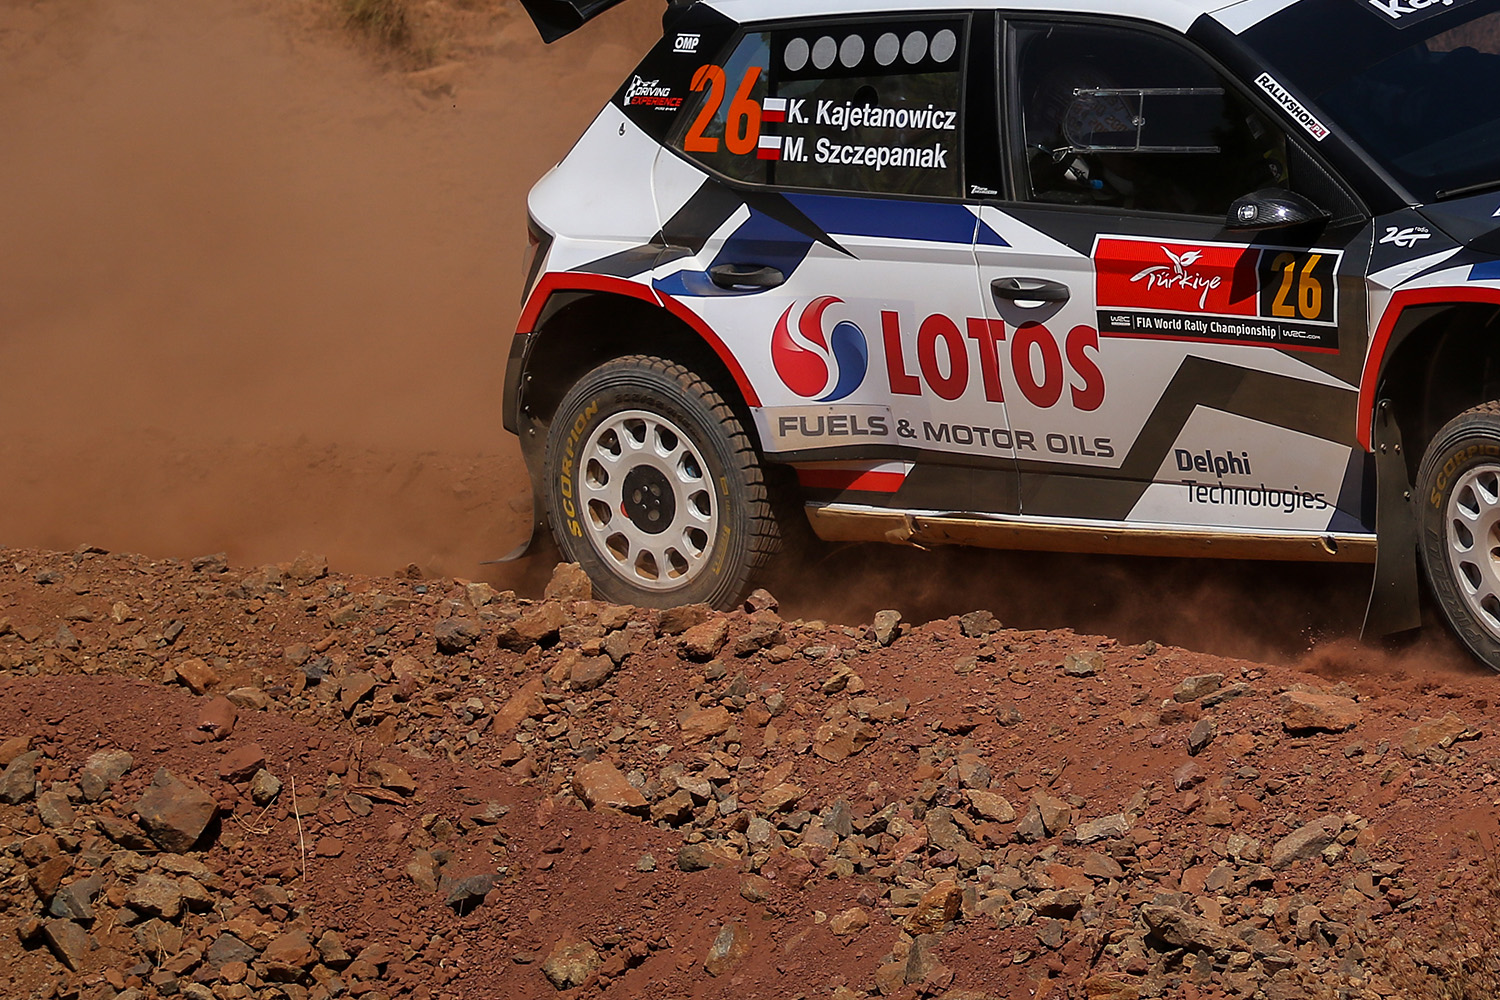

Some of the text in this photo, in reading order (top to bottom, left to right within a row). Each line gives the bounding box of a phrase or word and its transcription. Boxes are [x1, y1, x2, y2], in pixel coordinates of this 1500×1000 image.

[674, 35, 700, 50] OMP
[630, 96, 684, 108] EXPERIENCE
[634, 86, 672, 98] DRIVING
[684, 63, 763, 155] 26
[1258, 74, 1327, 138] RALLYSHOP.PL
[788, 98, 957, 131] K. Kajetanowicz
[782, 136, 809, 162] M.
[1130, 265, 1221, 310] Türkiye
[1270, 252, 1323, 319] 26
[1136, 316, 1152, 329] FIA
[1153, 317, 1182, 331] World
[1185, 319, 1208, 334] Rally
[1210, 321, 1277, 340] Championship
[881, 310, 1106, 412] LOTOS
[778, 416, 1115, 458] FUELS & MOTOR OILS
[559, 399, 599, 538] SCORPION
[1174, 448, 1252, 479] Delphi
[1181, 480, 1328, 514] Technologies
